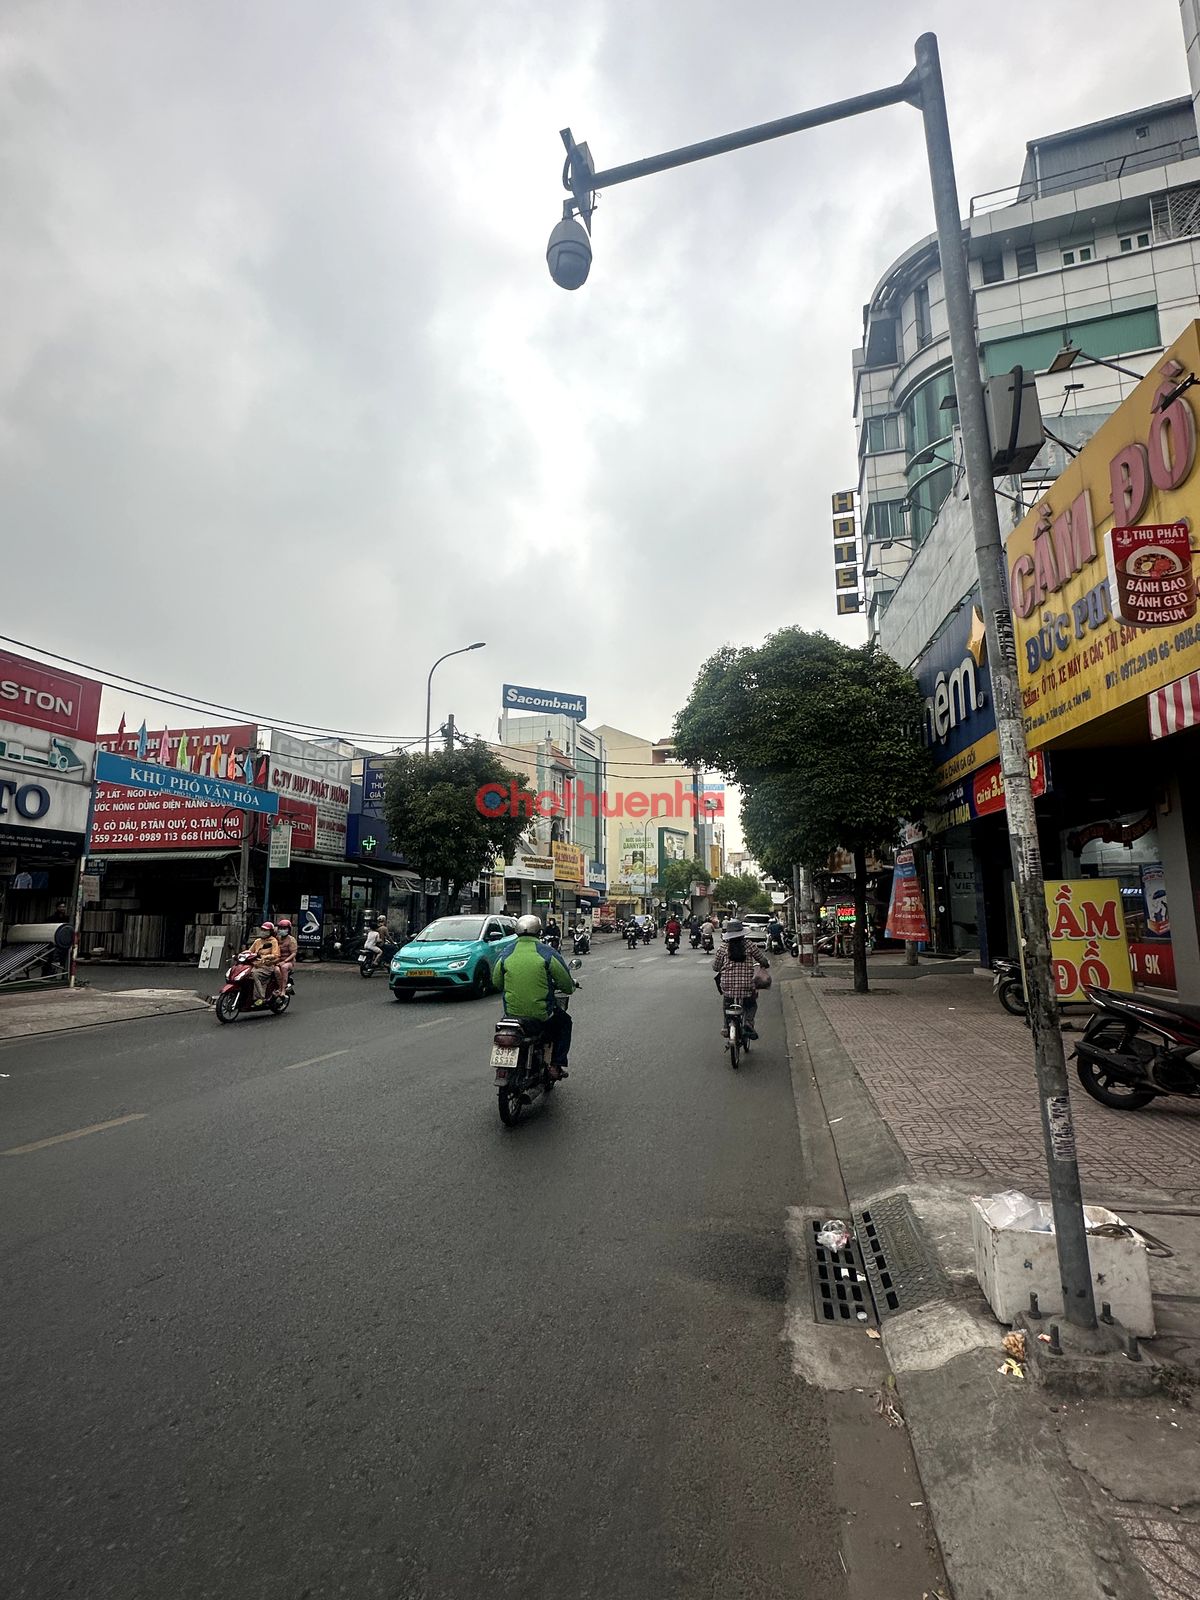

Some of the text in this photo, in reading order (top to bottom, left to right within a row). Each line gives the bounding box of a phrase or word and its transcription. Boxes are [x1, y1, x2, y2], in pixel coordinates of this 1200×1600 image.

[1132, 526, 1184, 542] THỌ PHÁT
[833, 492, 858, 613] HOTEL
[1126, 575, 1187, 592] BÁNH BAO
[1128, 591, 1188, 607] BÁNH GIÒ
[1137, 610, 1187, 622] DIMSUM
[1025, 611, 1070, 673] ĐỨC
[0, 680, 73, 716] STON
[505, 688, 584, 712] Sacombank
[130, 767, 165, 786] KHU
[203, 782, 230, 800] VĂN
[233, 790, 260, 806] HÓA
[94, 801, 110, 812] ƯỚC
[103, 819, 116, 830] GÒ
[119, 818, 138, 831] DẦU,
[95, 834, 110, 843] 559
[112, 833, 134, 842] 2240
[140, 832, 161, 841] 0989
[164, 832, 178, 840] 113
[181, 832, 198, 840] 668
[1048, 884, 1121, 938] ẦM
[1052, 940, 1111, 995] ĐỒ
[1145, 954, 1160, 975] 9K
